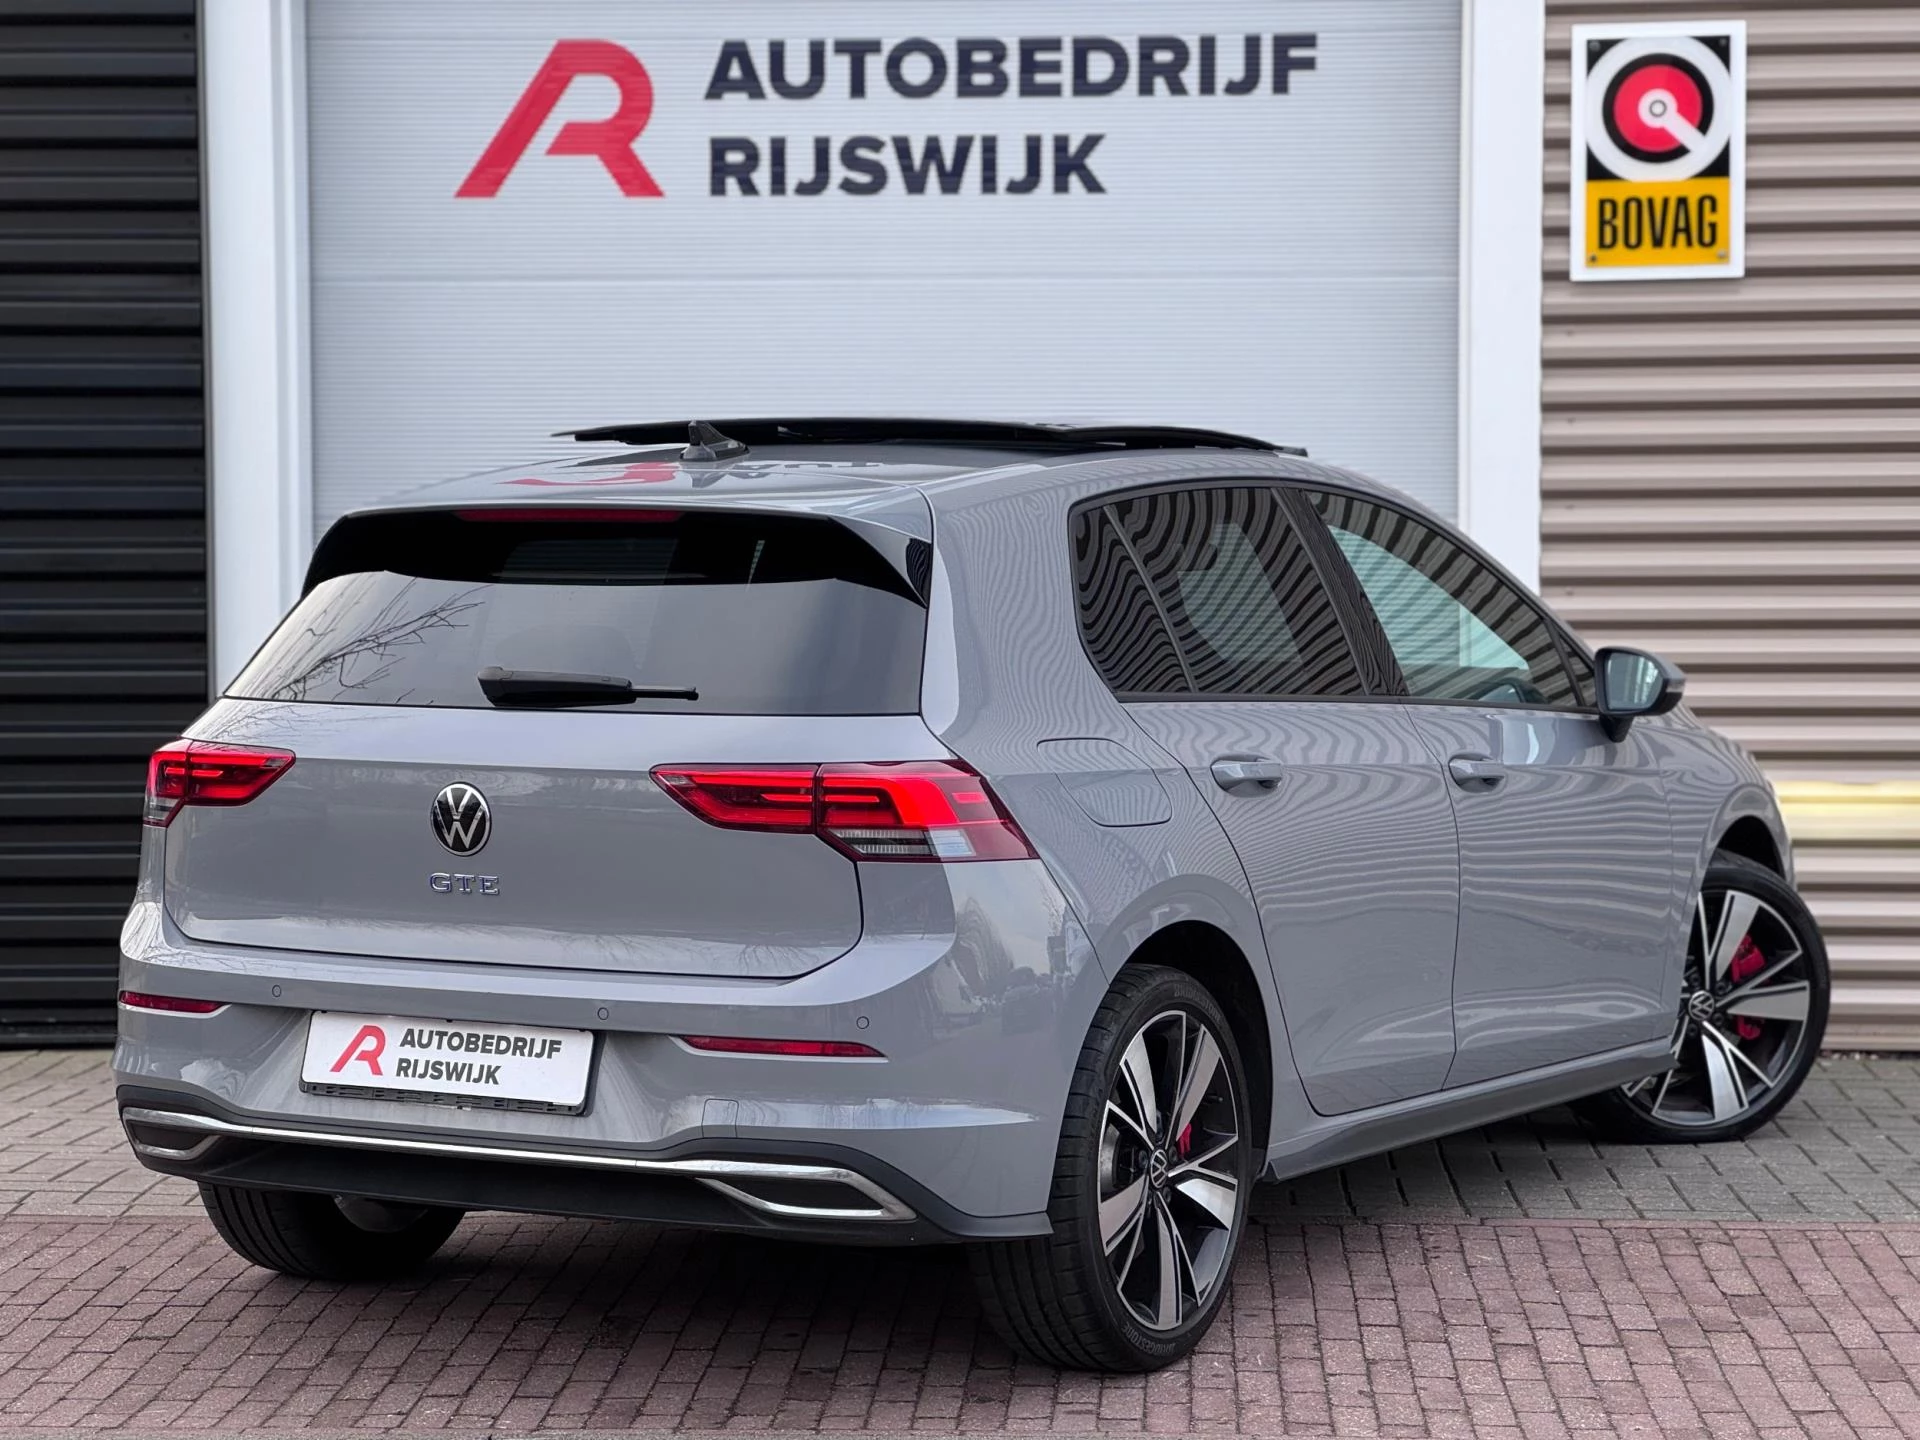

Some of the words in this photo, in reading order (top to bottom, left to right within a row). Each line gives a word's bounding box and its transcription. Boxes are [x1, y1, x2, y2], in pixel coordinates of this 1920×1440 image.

[704, 34, 1318, 100] AUTOBEDRIJF
[709, 134, 1107, 196] RIJSWIJK
[1597, 195, 1718, 250] BOVAG
[429, 872, 500, 895] GTE
[399, 1028, 562, 1060] AUTOBEDRIJF
[395, 1057, 502, 1085] RIJSWIJK
